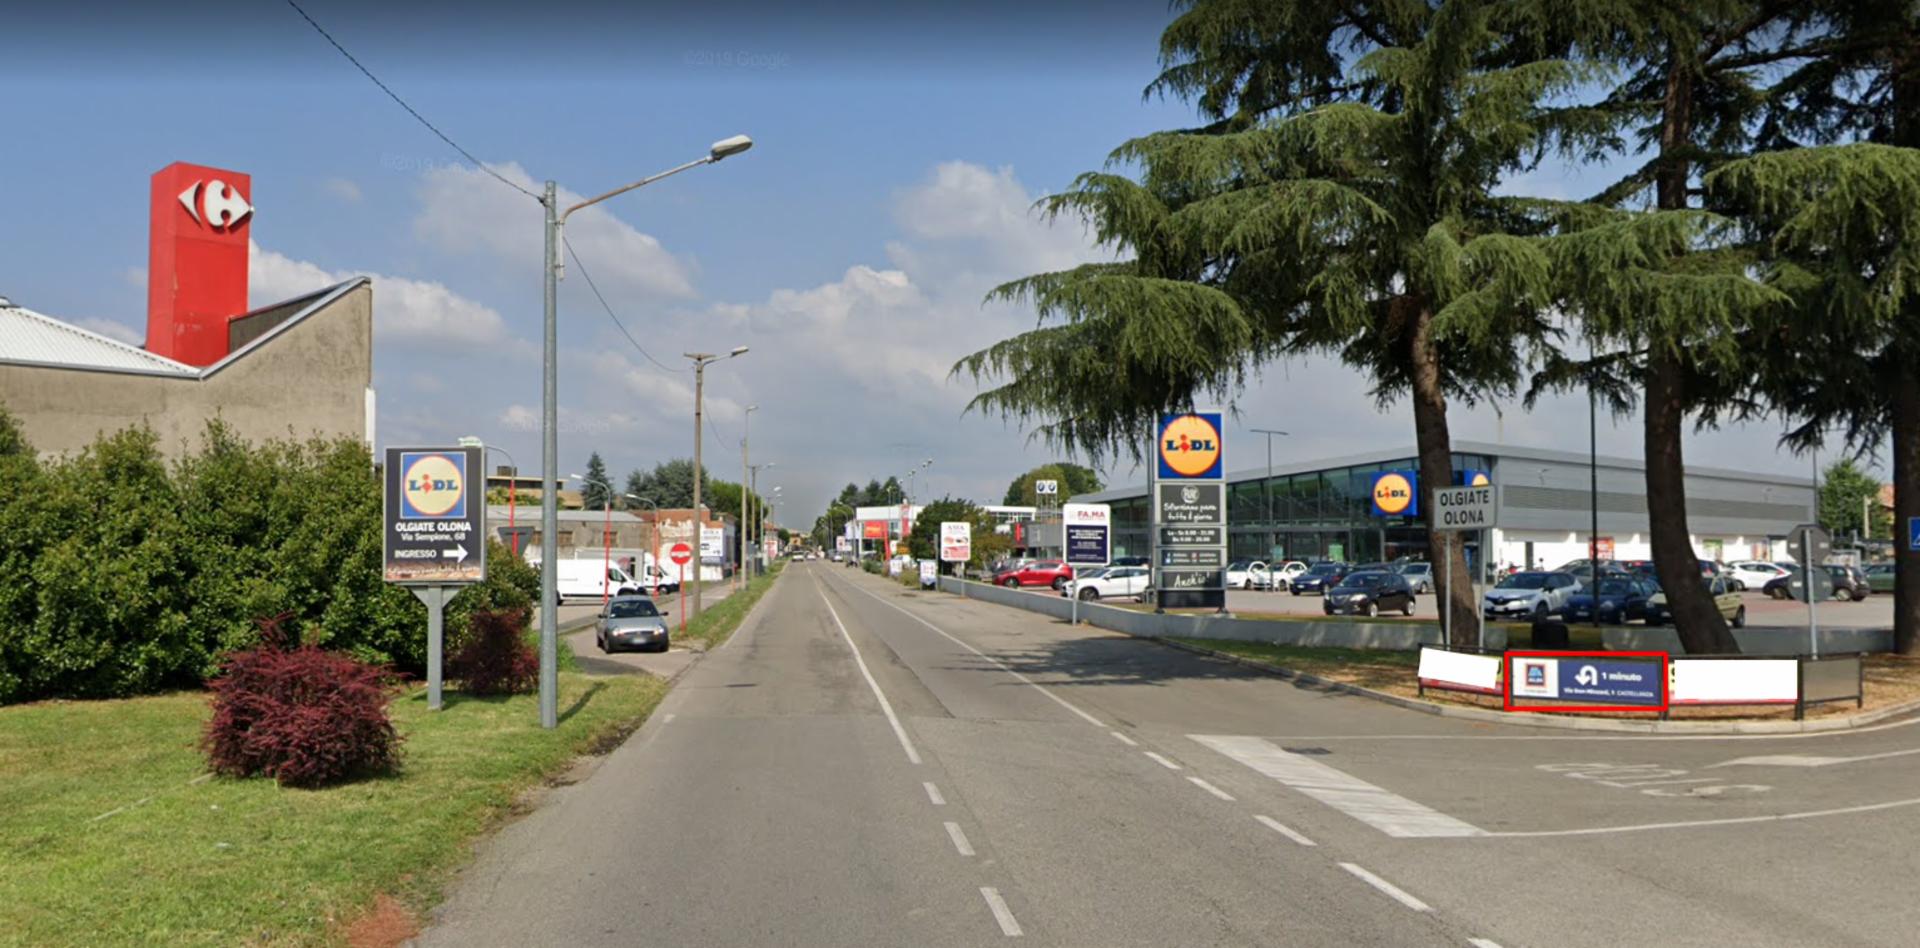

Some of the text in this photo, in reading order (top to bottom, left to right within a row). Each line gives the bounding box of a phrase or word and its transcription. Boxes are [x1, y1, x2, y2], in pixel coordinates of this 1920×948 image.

[1440, 489, 1489, 507] OLGIATE
[1444, 510, 1484, 525] OLONA
[395, 522, 472, 532] OLGIATE OLONA
[401, 533, 413, 541] Via
[414, 533, 452, 543] Sempione,
[394, 549, 437, 559] INGRESSO
[1601, 671, 1642, 681] 1 minuto
